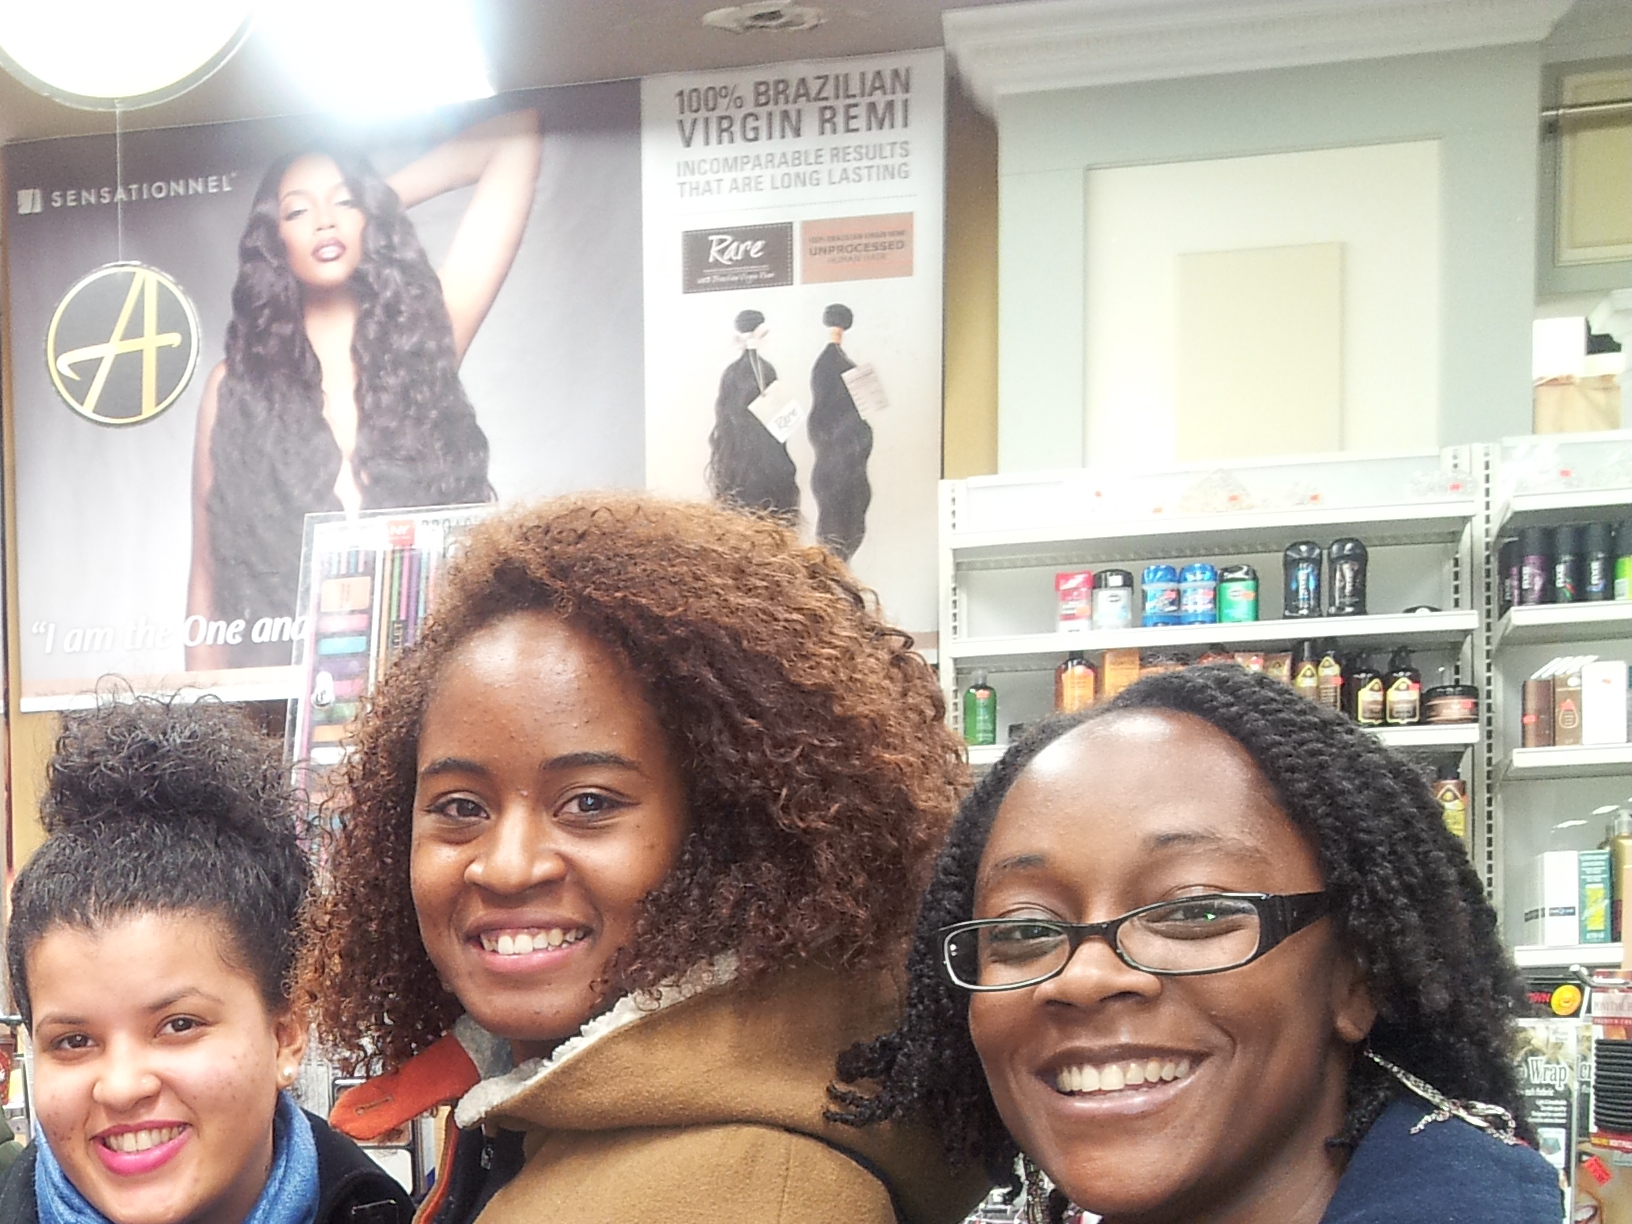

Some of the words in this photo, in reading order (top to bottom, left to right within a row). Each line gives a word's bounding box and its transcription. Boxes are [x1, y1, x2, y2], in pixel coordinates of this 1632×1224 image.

[674, 84, 744, 115] 100%
[753, 66, 911, 108] BRAZILIAN
[676, 108, 803, 149] VIRGIN
[818, 98, 910, 136] REMI
[676, 147, 828, 178] INCOMPARABLE
[830, 140, 910, 165] RESULTS
[51, 173, 234, 208] SENSATIONNEL
[677, 178, 723, 198] THAT
[728, 175, 764, 194] ARE
[770, 170, 820, 191] LONG
[827, 162, 910, 185] LASTING
[707, 234, 767, 266] Rare
[808, 239, 905, 257] UNPROCESSED
[63, 626, 114, 655] am
[183, 614, 244, 648] One
[1528, 1056, 1569, 1091] Wrap
